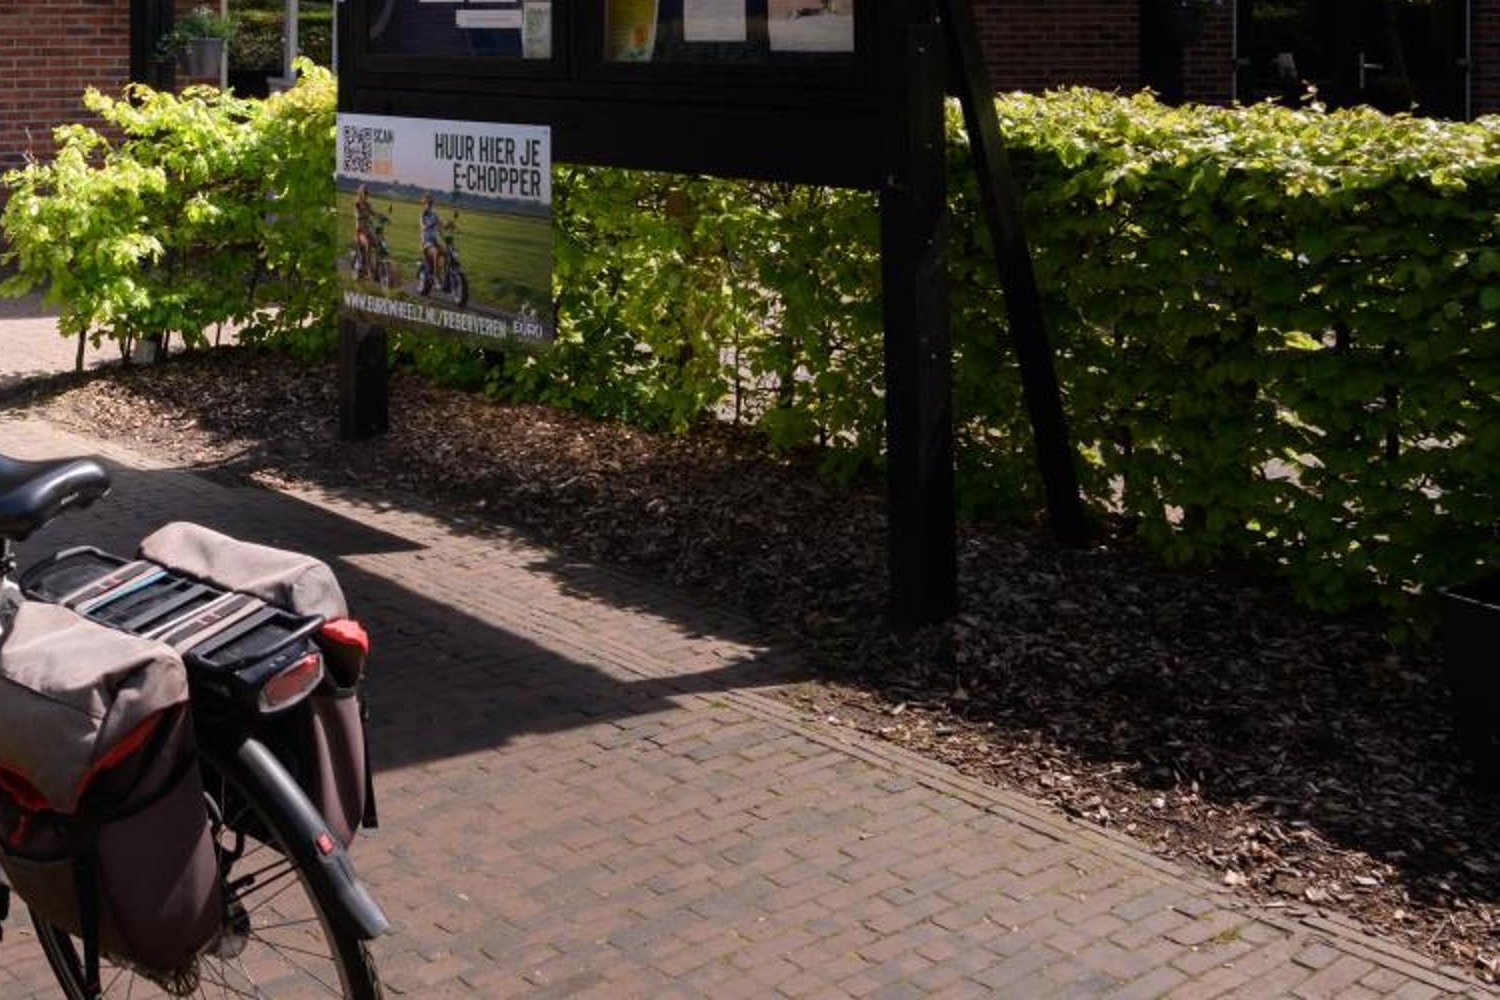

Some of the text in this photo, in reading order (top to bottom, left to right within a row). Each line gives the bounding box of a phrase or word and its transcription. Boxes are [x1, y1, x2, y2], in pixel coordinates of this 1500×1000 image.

[435, 133, 541, 168] HUUR HIER JE
[453, 163, 542, 198] E-CHOPPER
